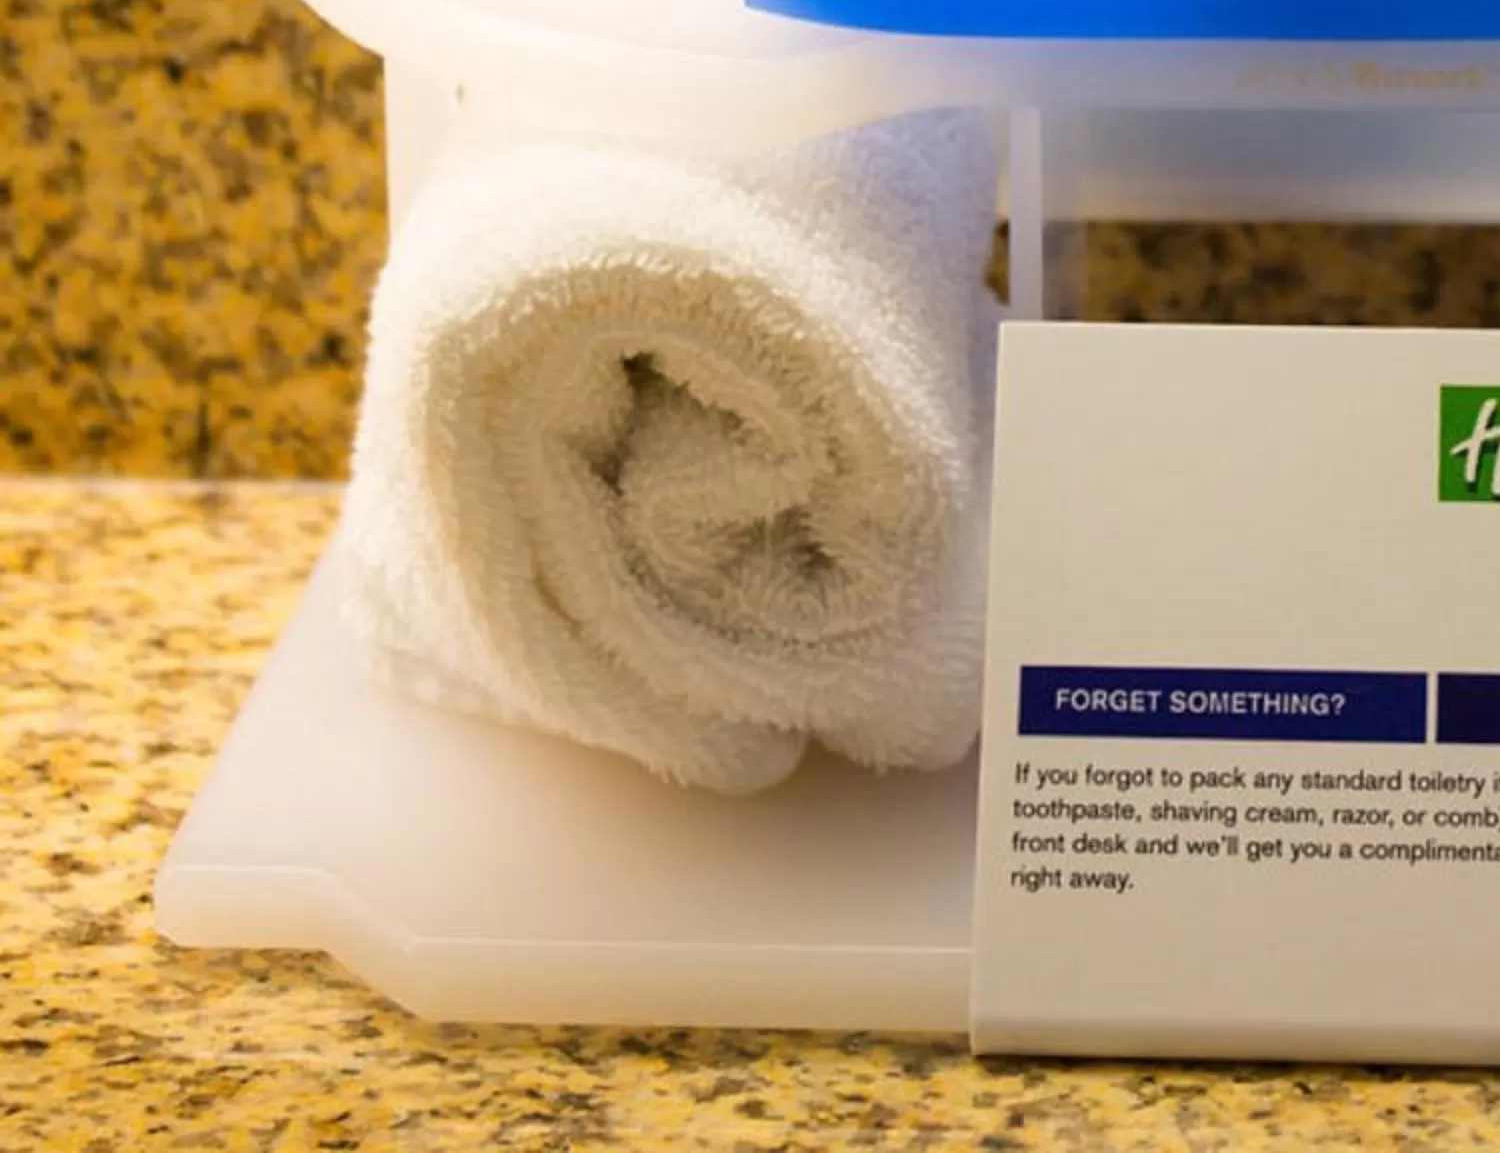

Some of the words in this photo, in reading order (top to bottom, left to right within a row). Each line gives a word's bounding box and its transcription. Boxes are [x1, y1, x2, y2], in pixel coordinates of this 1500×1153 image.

[1055, 688, 1163, 712] FORGET
[1169, 690, 1346, 715] SOMETHING?
[1016, 762, 1030, 784] If
[1036, 767, 1078, 791] you
[1084, 764, 1154, 791] forgot
[1160, 767, 1183, 787] to
[1189, 766, 1247, 792] pack
[1253, 773, 1294, 795] any
[1301, 769, 1402, 792] standard
[1409, 771, 1485, 798] toiletry
[1013, 798, 1143, 823] toothpaste,
[1150, 801, 1238, 827] shaving
[1244, 807, 1324, 827] cream,
[1331, 808, 1395, 829] razor,
[1402, 809, 1427, 826] or
[1011, 831, 1065, 854] front
[1072, 834, 1127, 855] desk
[1134, 835, 1179, 856] and
[1186, 835, 1239, 857] we'll
[1246, 838, 1283, 862] get
[1290, 841, 1332, 863] you
[1339, 842, 1352, 859] a
[1010, 866, 1061, 893] right
[1069, 870, 1134, 894] away.
